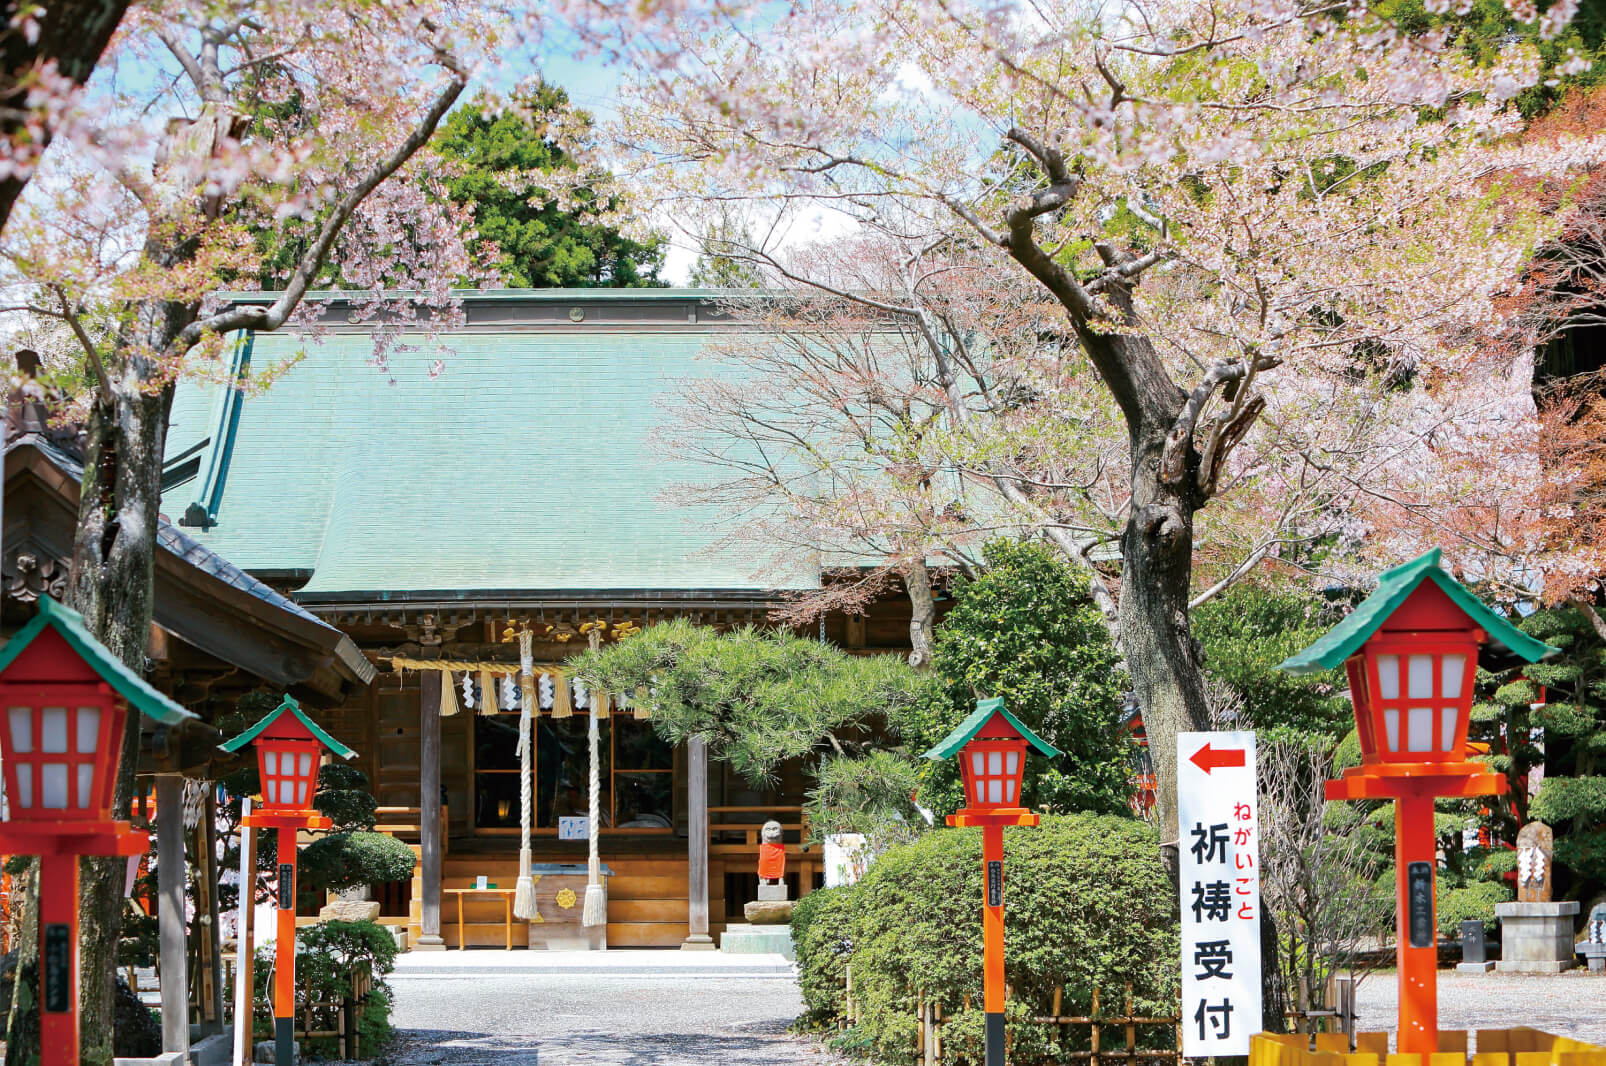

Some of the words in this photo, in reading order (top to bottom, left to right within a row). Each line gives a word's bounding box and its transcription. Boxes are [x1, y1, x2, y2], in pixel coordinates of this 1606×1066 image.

[1191, 822, 1234, 1040] 祈祷受付
[1234, 802, 1254, 920] ねがいごと
